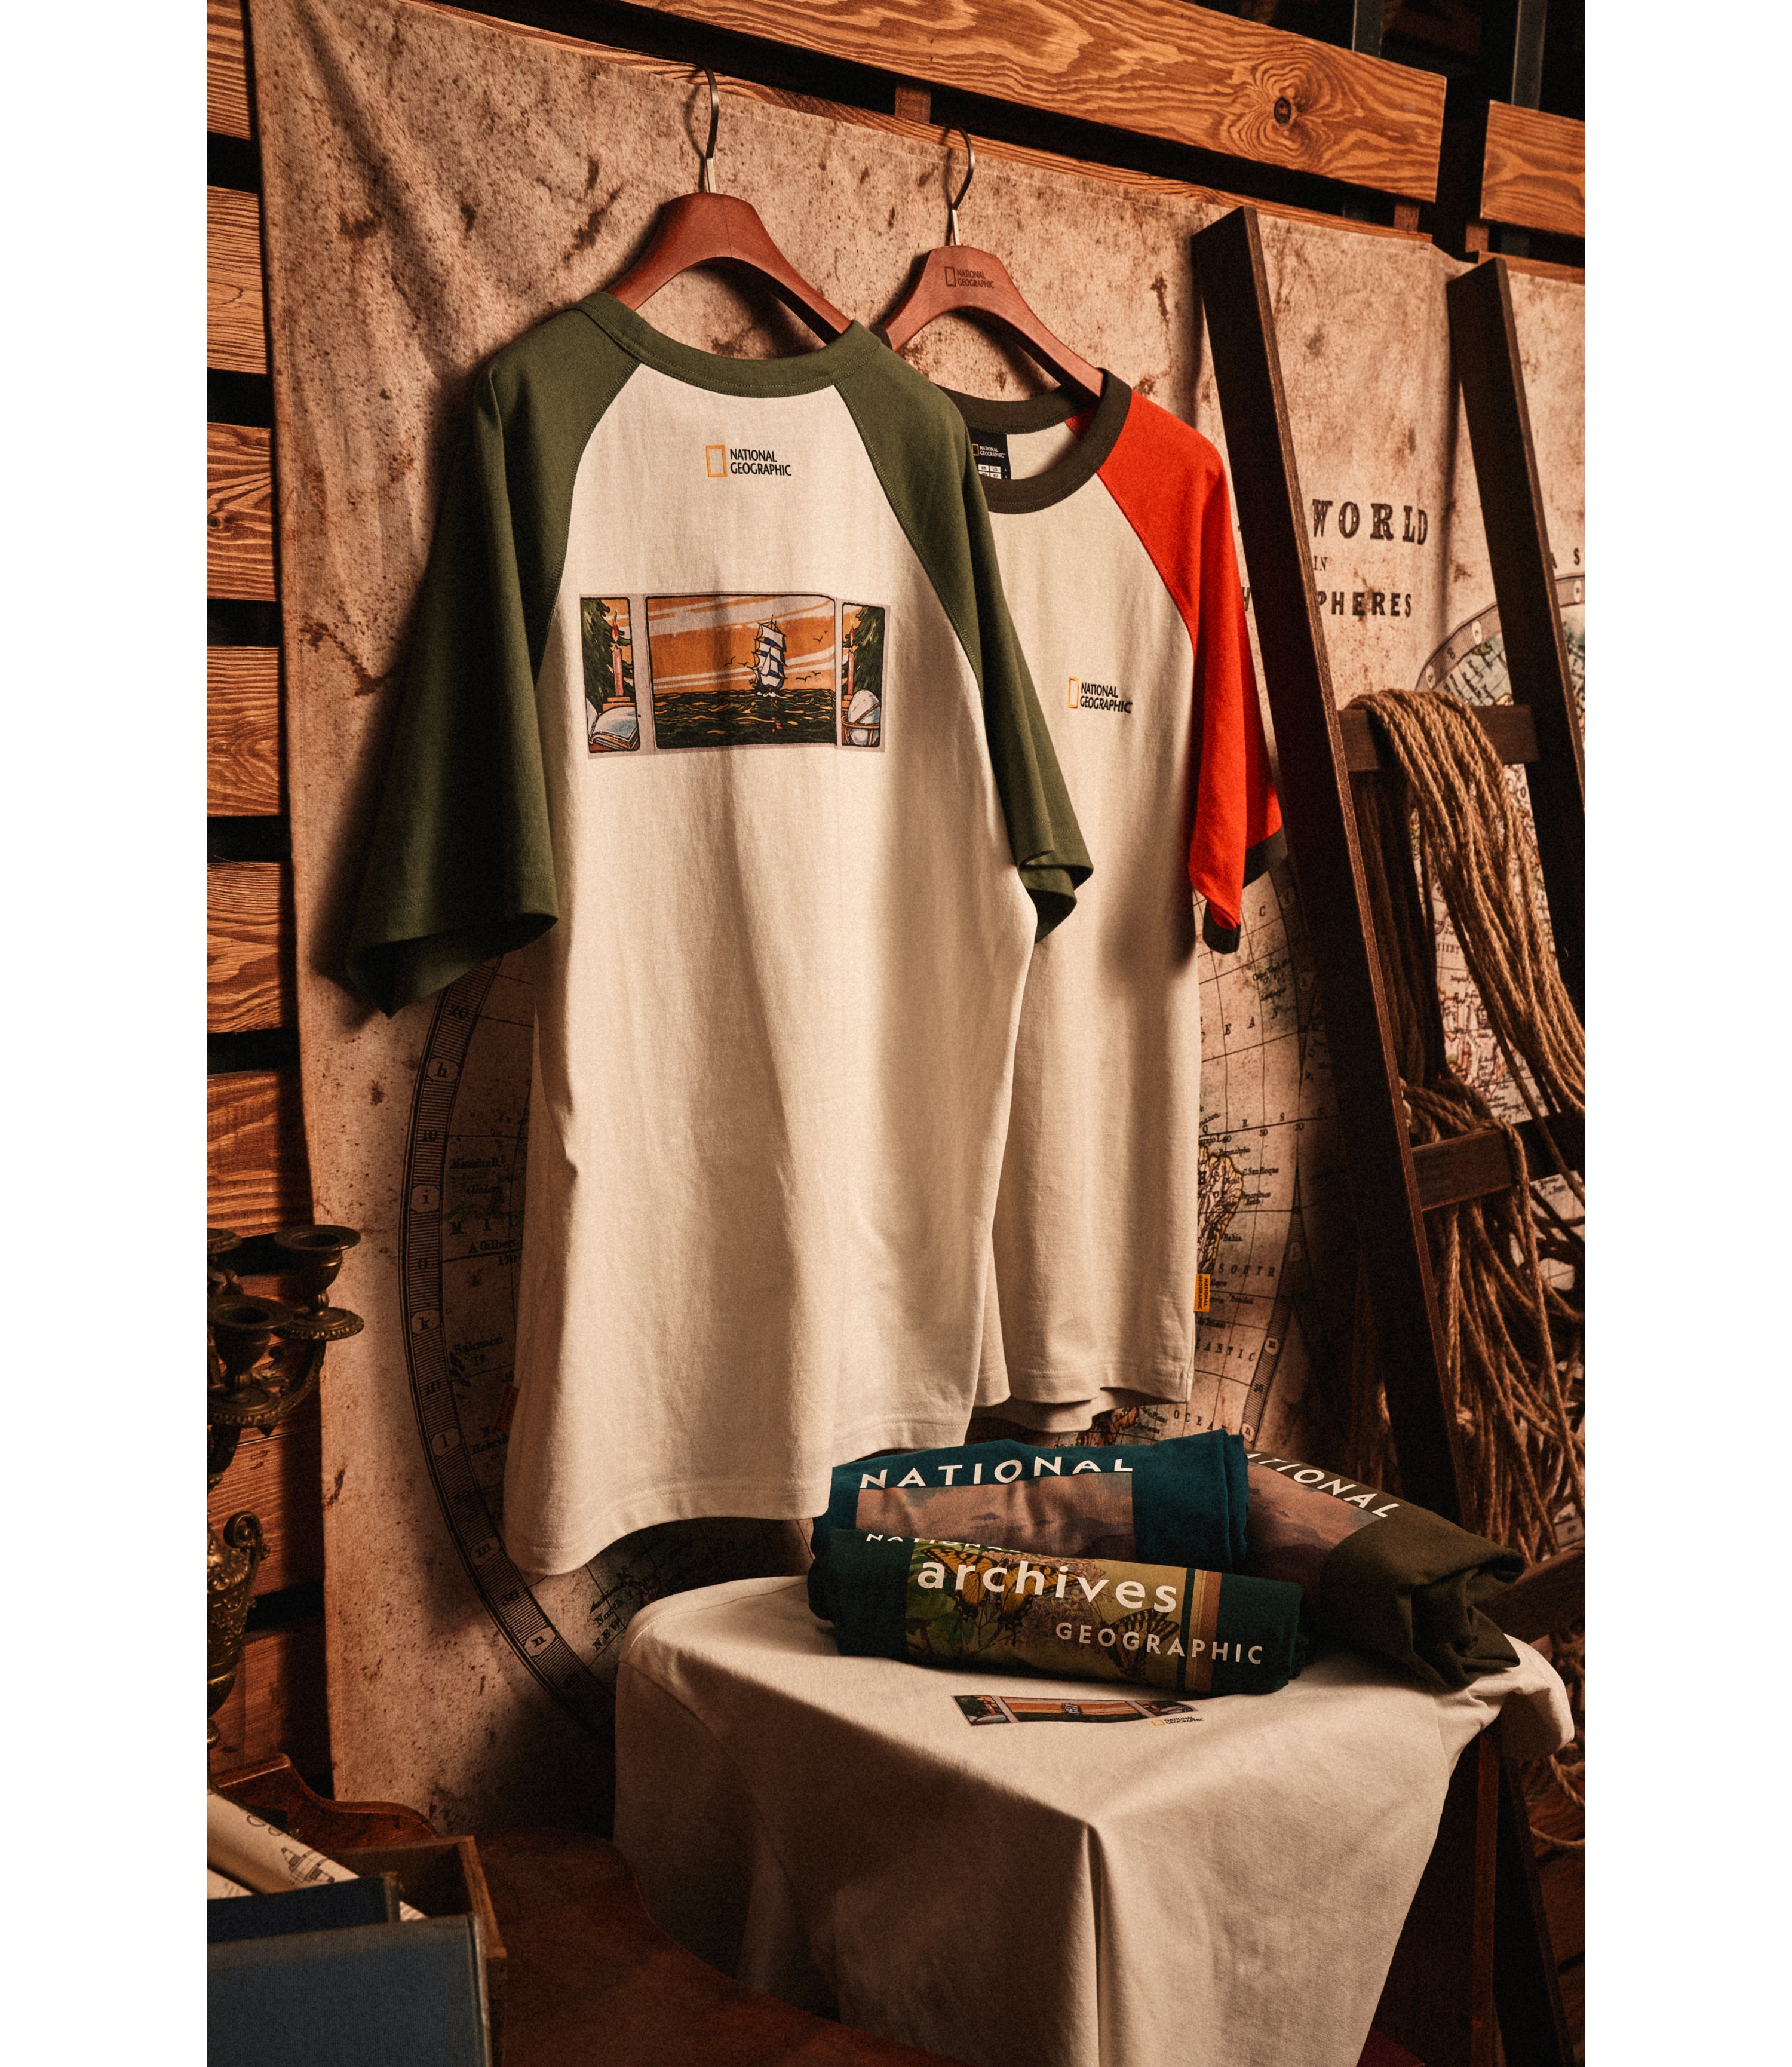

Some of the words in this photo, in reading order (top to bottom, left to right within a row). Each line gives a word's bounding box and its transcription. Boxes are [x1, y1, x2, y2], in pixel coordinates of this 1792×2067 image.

[957, 269, 986, 279] NATIONAL
[958, 278, 994, 289] GEOGRAPHIC
[729, 449, 778, 462] NATIONAL
[730, 462, 792, 476] GEOGRAPHIC
[1312, 499, 1428, 545] WORLD
[1314, 556, 1328, 571] IN
[1081, 682, 1118, 698] NATIONAL
[1080, 695, 1133, 714] GEOGRAPHIC
[1218, 1263, 1276, 1277] SOUTH
[860, 1456, 1133, 1489] NATIONAL
[918, 1560, 1177, 1613] archives
[1055, 1622, 1263, 1664] GEOGRAPHIC
